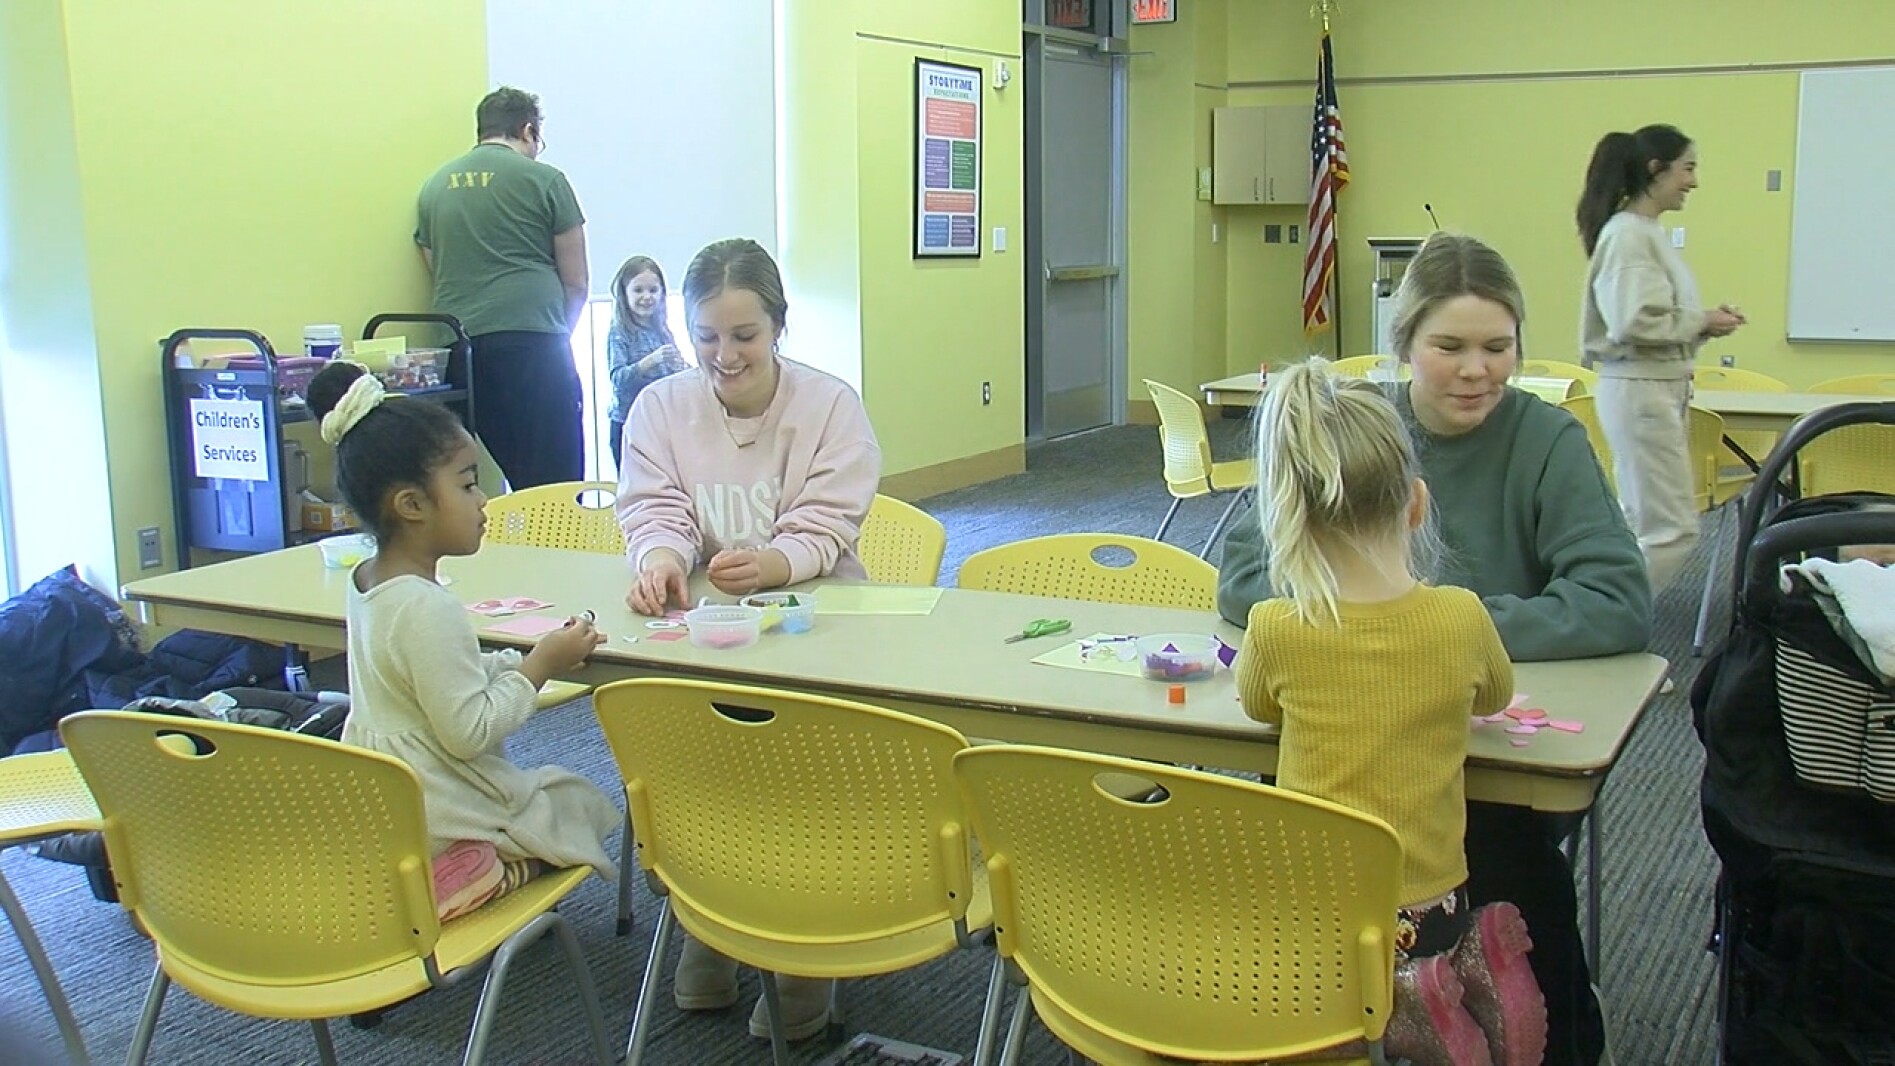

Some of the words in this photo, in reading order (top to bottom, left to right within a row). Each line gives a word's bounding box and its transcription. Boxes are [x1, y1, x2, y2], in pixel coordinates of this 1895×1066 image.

[1136, 0, 1168, 19] EXIT
[447, 171, 496, 189] XXV
[196, 410, 260, 429] Children's
[203, 444, 257, 462] Services
